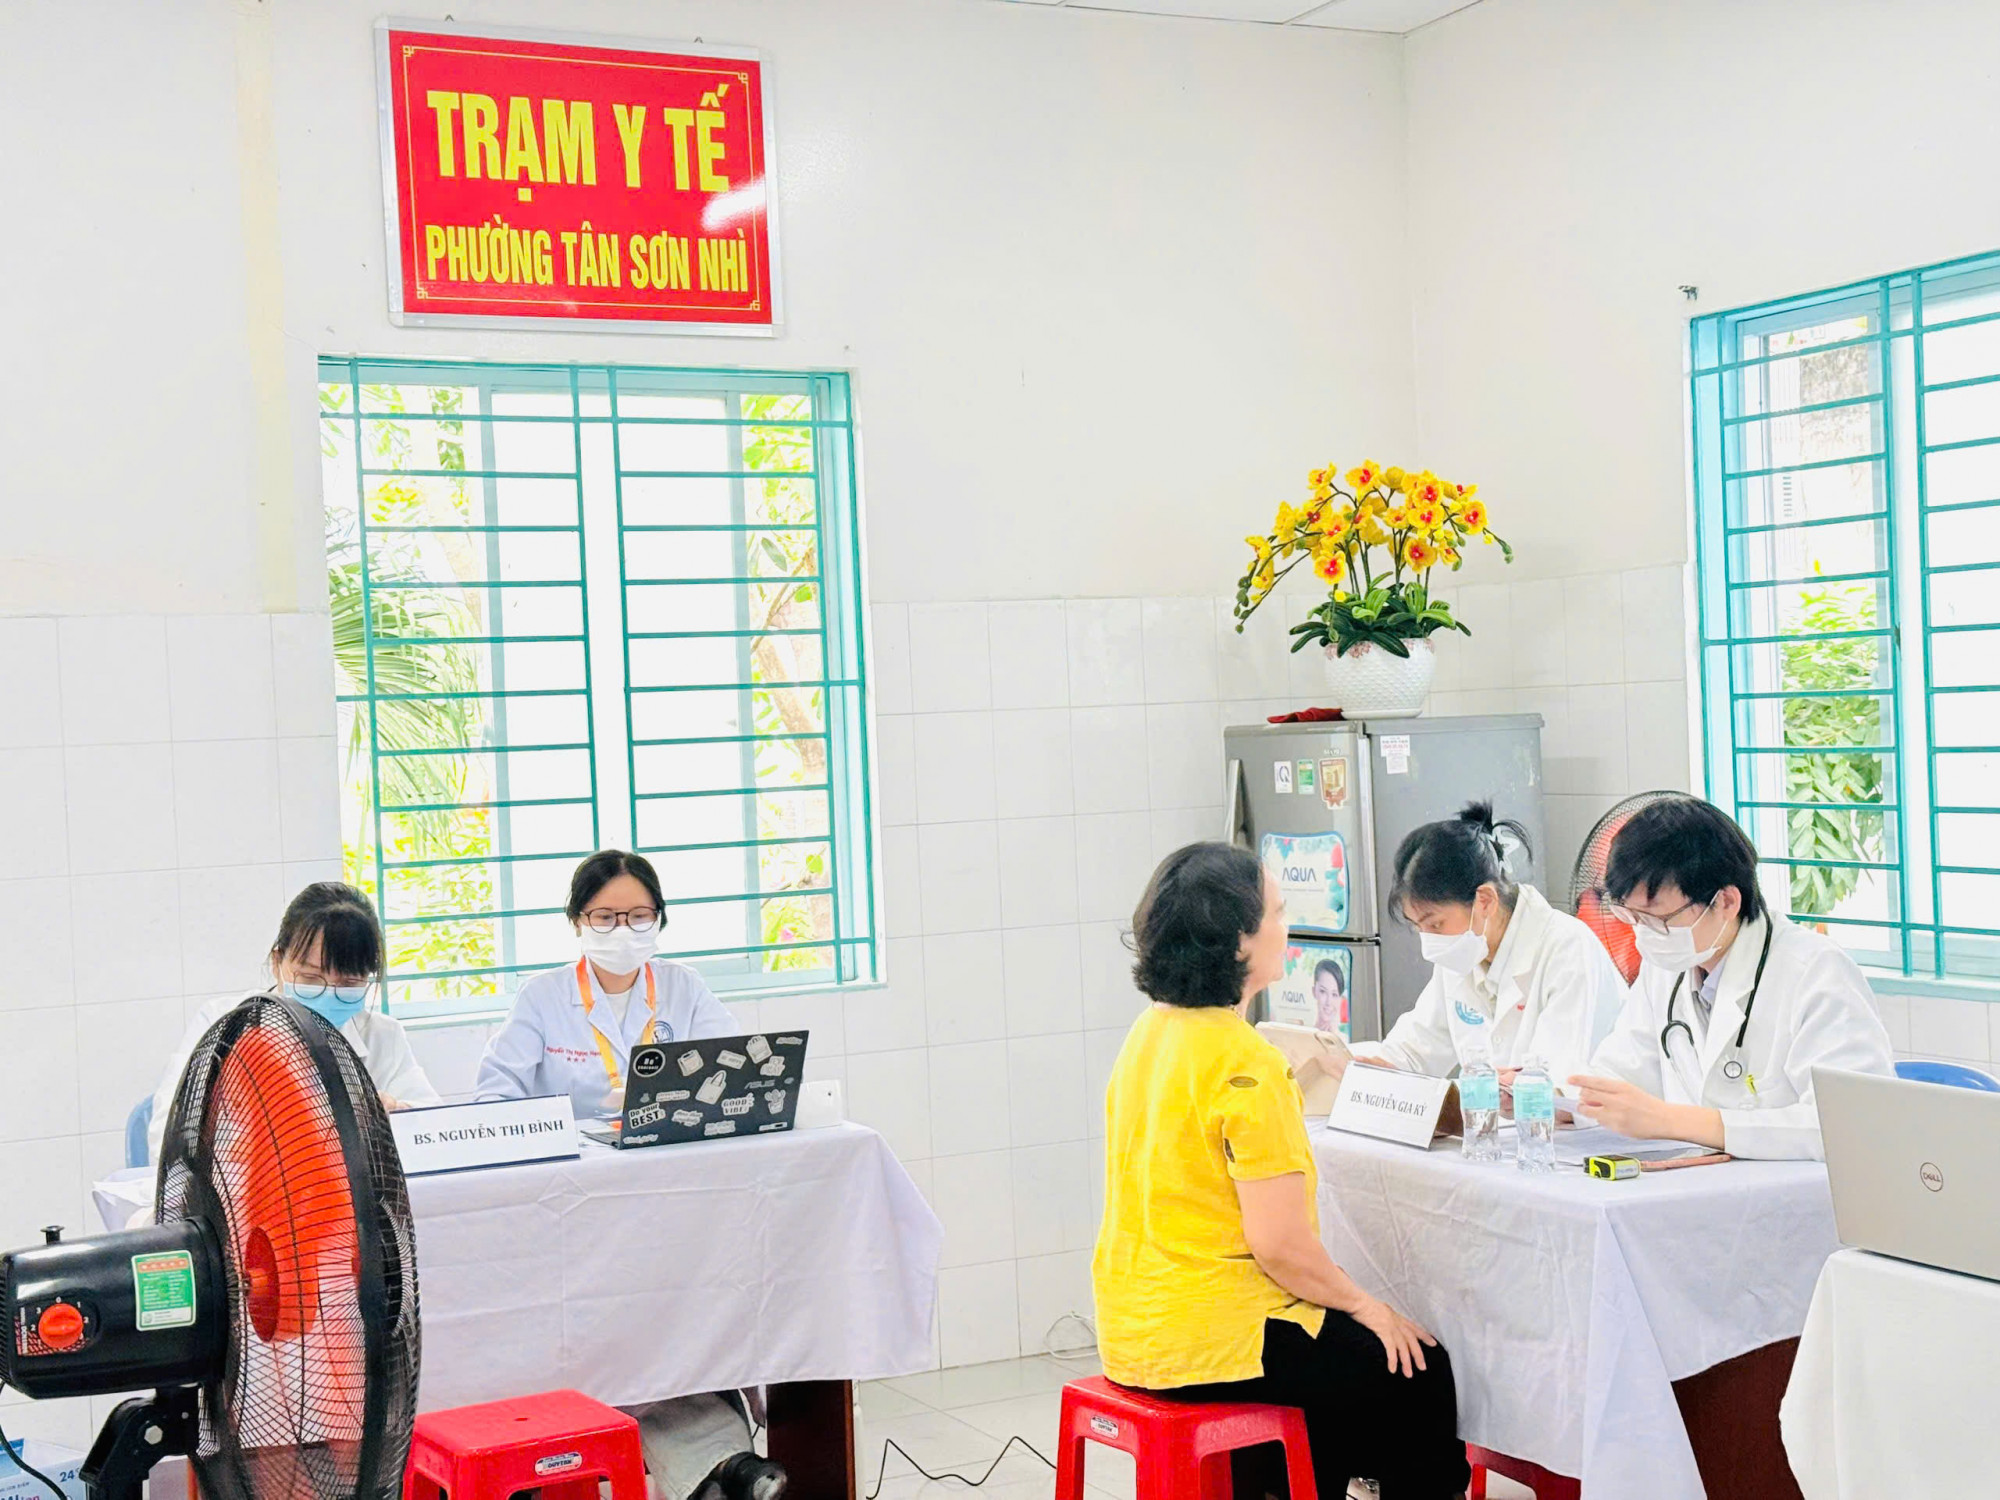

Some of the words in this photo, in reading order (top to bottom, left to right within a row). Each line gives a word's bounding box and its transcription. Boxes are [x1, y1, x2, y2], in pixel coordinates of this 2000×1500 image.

[426, 90, 597, 202] TRẠM
[612, 104, 646, 188] Y
[663, 84, 730, 192] TẾ
[425, 213, 554, 285] PHƯỜNG
[560, 220, 622, 287] TÂN
[629, 230, 691, 290] SƠN
[698, 227, 749, 292] NHÌ
[642, 1104, 659, 1114] your
[1397, 1100, 1413, 1115] GIA
[631, 1110, 660, 1127] BEST
[414, 1133, 436, 1145] BS.
[439, 1123, 496, 1142] NGUYỄN
[499, 1124, 525, 1138] THỊ
